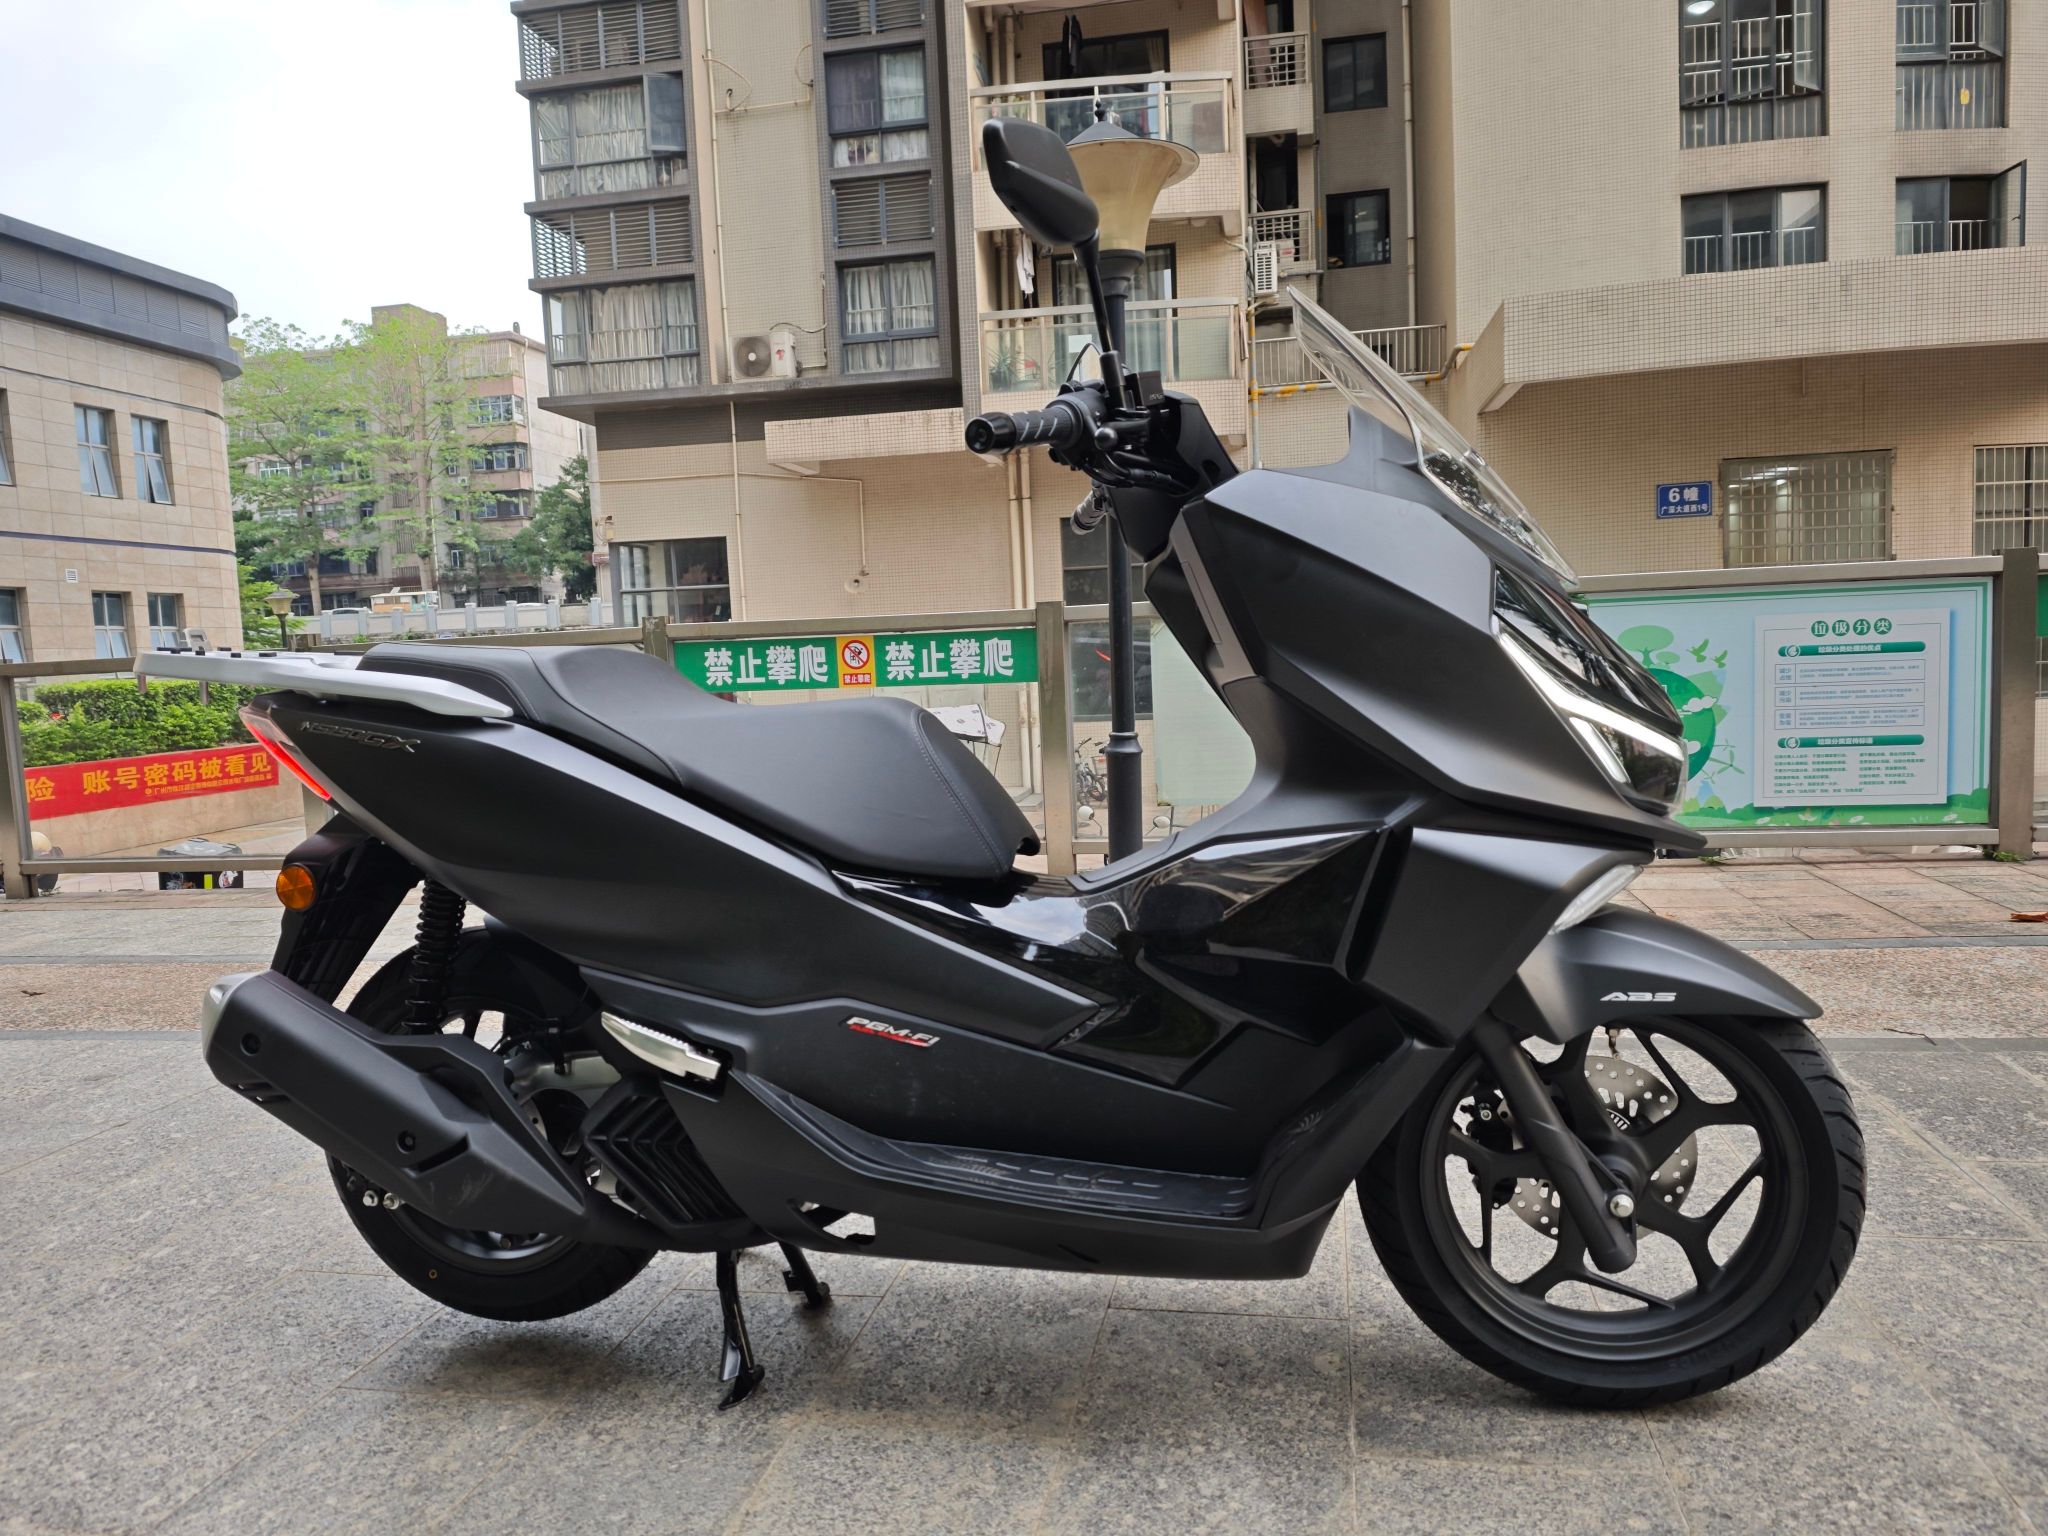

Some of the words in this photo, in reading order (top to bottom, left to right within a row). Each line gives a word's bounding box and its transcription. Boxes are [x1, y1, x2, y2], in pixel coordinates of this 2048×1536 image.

[1814, 620, 1889, 635] 垃圾分类
[704, 645, 828, 686] 禁止攀爬
[885, 637, 1014, 680] 禁止攀爬
[82, 751, 272, 796] 账号密码被看见
[1600, 992, 1677, 1001] ABS
